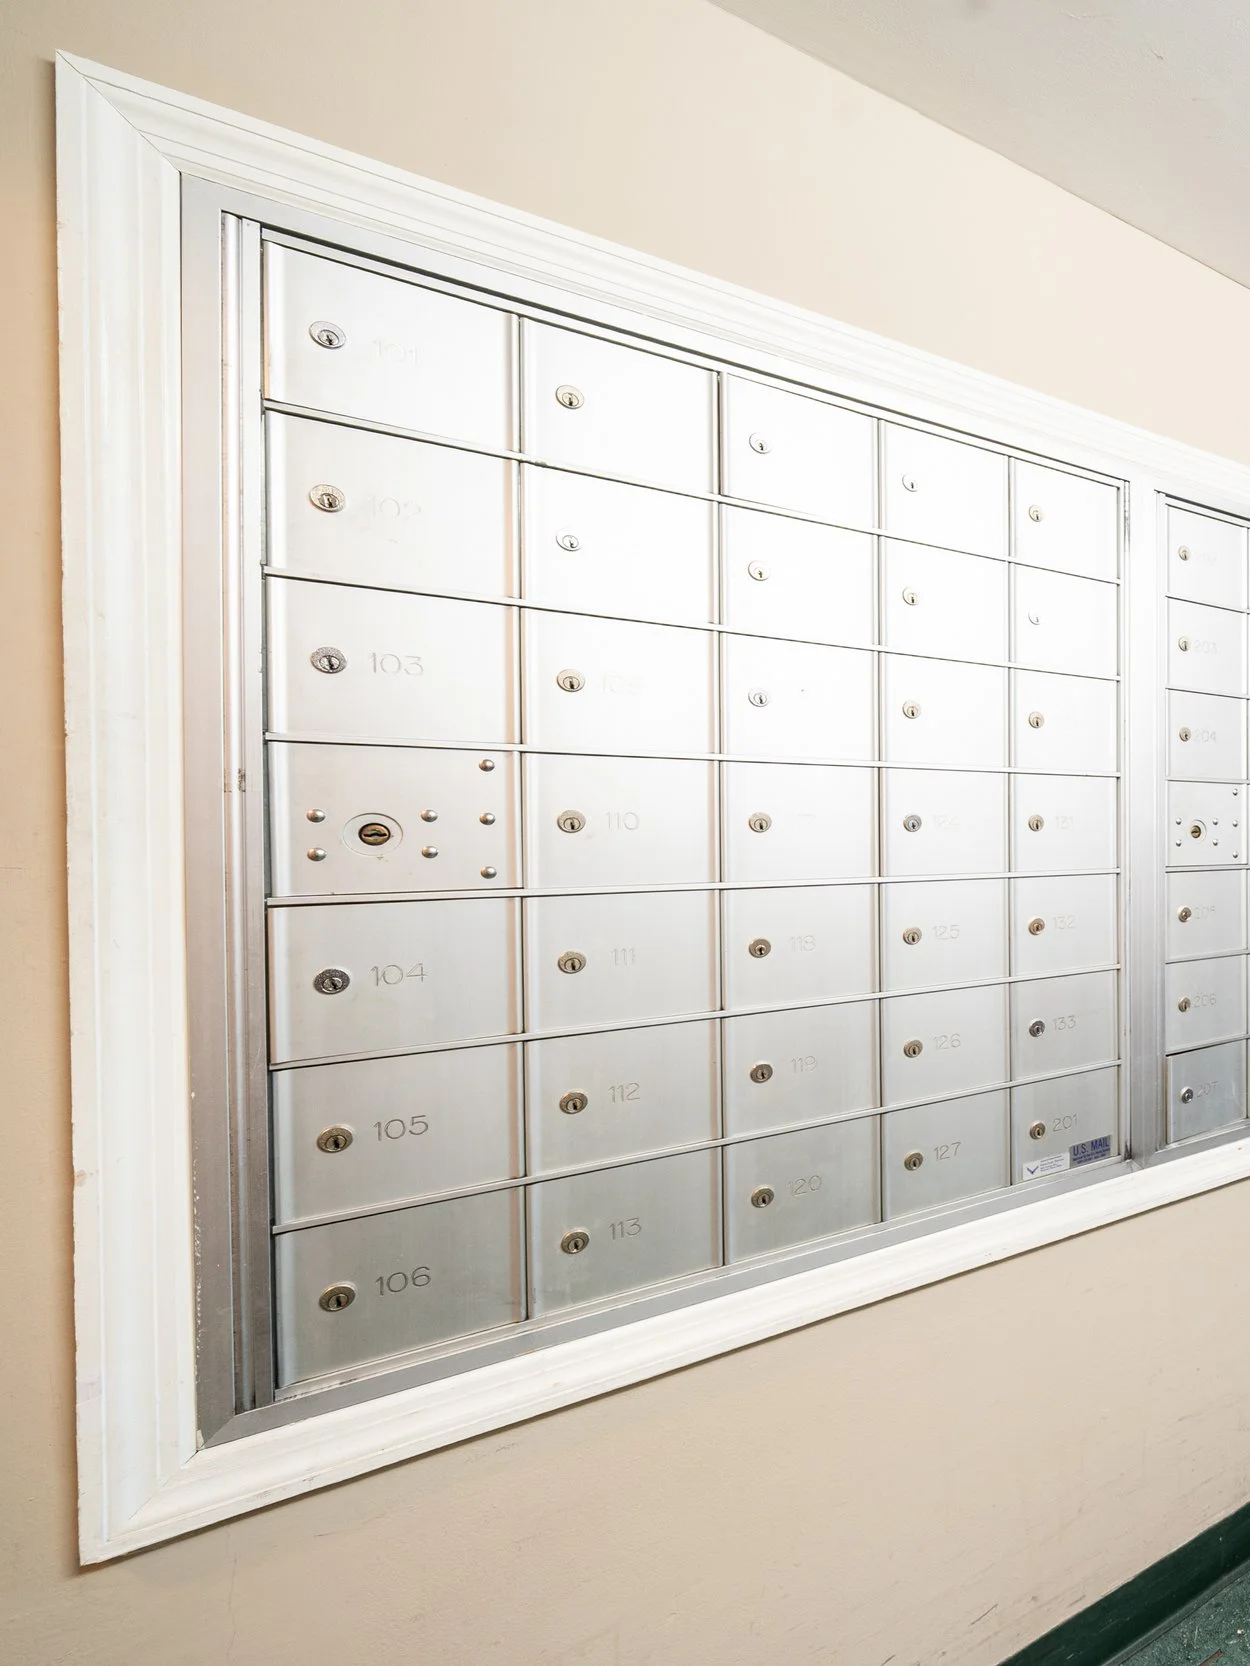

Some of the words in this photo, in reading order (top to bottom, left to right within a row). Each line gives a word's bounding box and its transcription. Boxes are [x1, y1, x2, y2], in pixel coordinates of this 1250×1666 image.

[372, 337, 420, 365] 101
[369, 496, 422, 521] 102
[1194, 640, 1217, 653] 203
[368, 650, 424, 676] 103
[1194, 729, 1216, 742] 204
[605, 810, 640, 831] 110
[933, 925, 960, 940] 125
[1053, 915, 1076, 931] 132
[790, 935, 817, 952] 118
[612, 946, 637, 966] 111
[370, 962, 429, 987] 104
[1194, 992, 1216, 1008] 206
[1052, 1015, 1077, 1031] 133
[934, 1033, 962, 1050] 126
[790, 1055, 818, 1073] 119
[609, 1082, 641, 1103] 112
[1197, 1081, 1219, 1098] 207
[373, 1115, 430, 1141] 105
[1052, 1113, 1078, 1132] 201
[934, 1141, 961, 1160] 127
[1073, 1143, 1088, 1156] U.S.
[1091, 1137, 1110, 1150] MAIL
[787, 1175, 822, 1196] 120
[609, 1217, 642, 1241] 113
[374, 1265, 432, 1296] 106
